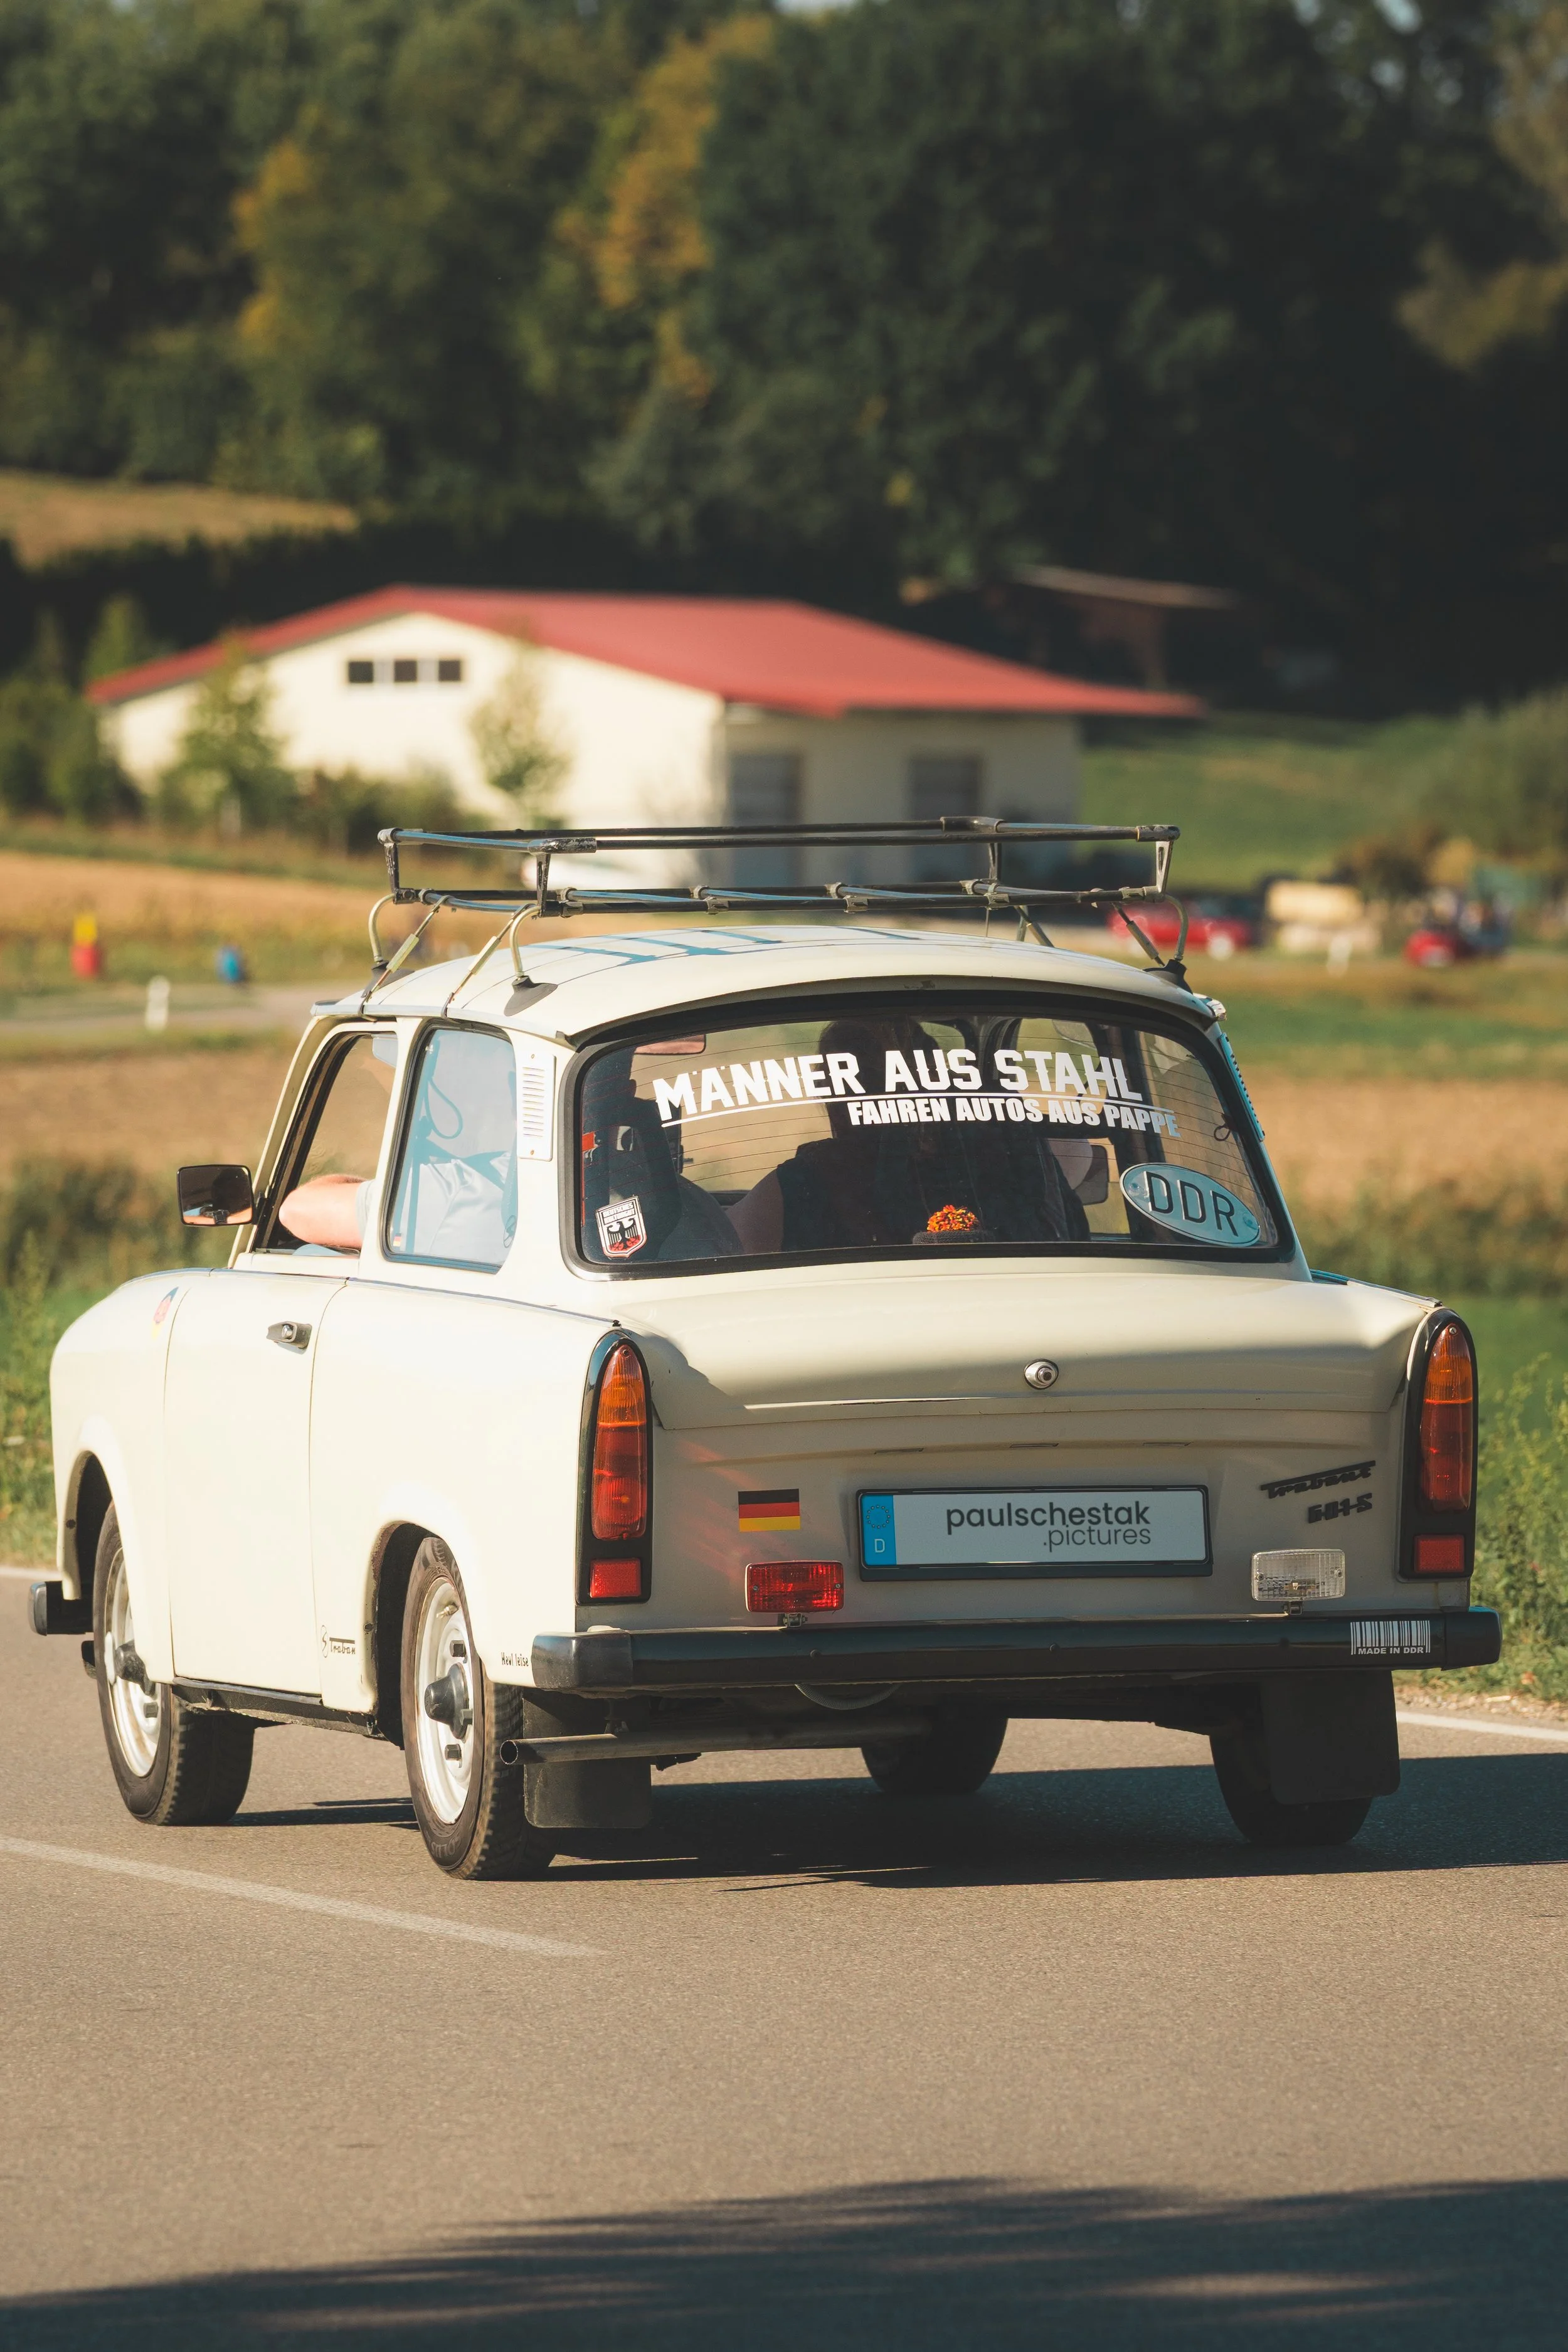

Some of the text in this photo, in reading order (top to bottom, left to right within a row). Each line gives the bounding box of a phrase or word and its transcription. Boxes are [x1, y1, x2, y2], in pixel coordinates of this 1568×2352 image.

[652, 1049, 1143, 1121] MÄNNER AUS STAHL
[847, 1098, 1180, 1138] FAHREN AUTOS AUS PAPPE
[1143, 1170, 1239, 1237] DDR
[946, 1500, 1150, 1535] paulschestak
[874, 1538, 886, 1553] D
[1043, 1524, 1152, 1552] .pictures
[515, 1653, 529, 1666] leise
